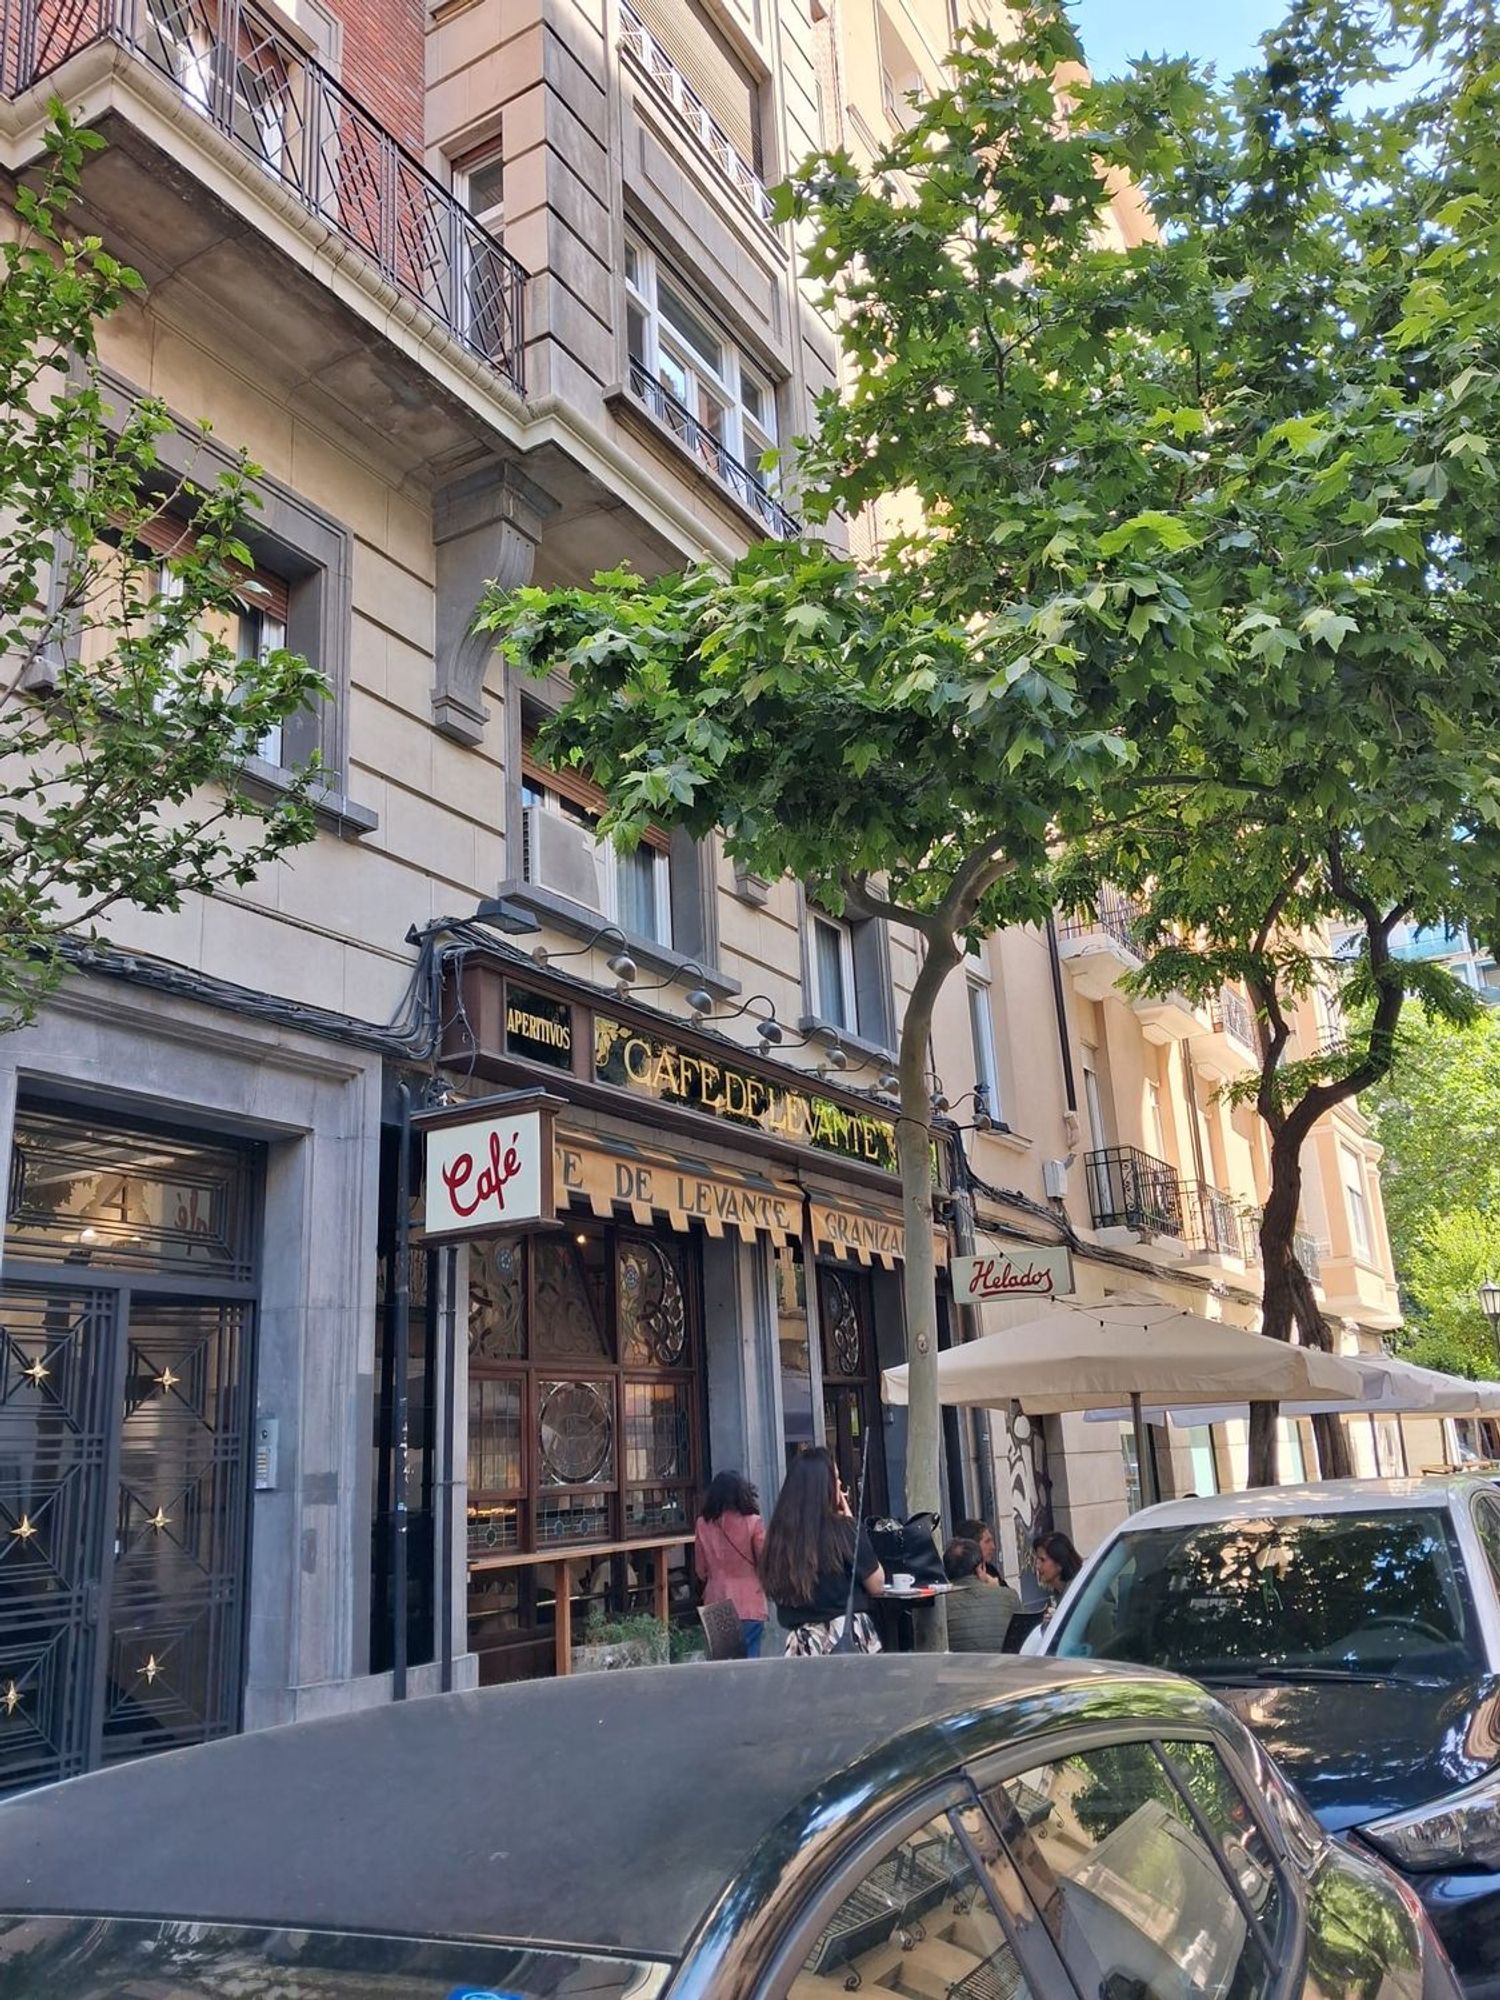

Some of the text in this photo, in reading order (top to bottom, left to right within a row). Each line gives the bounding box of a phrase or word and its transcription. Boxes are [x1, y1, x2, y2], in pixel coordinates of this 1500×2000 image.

[506, 1007, 571, 1050] APERITIVOS
[624, 1038, 879, 1160] CAFE DE LEVANTE
[101, 1174, 128, 1223] 4
[442, 1131, 521, 1217] Café
[556, 1150, 792, 1229] E DE LEVANTE
[968, 1259, 1054, 1298] Helados
